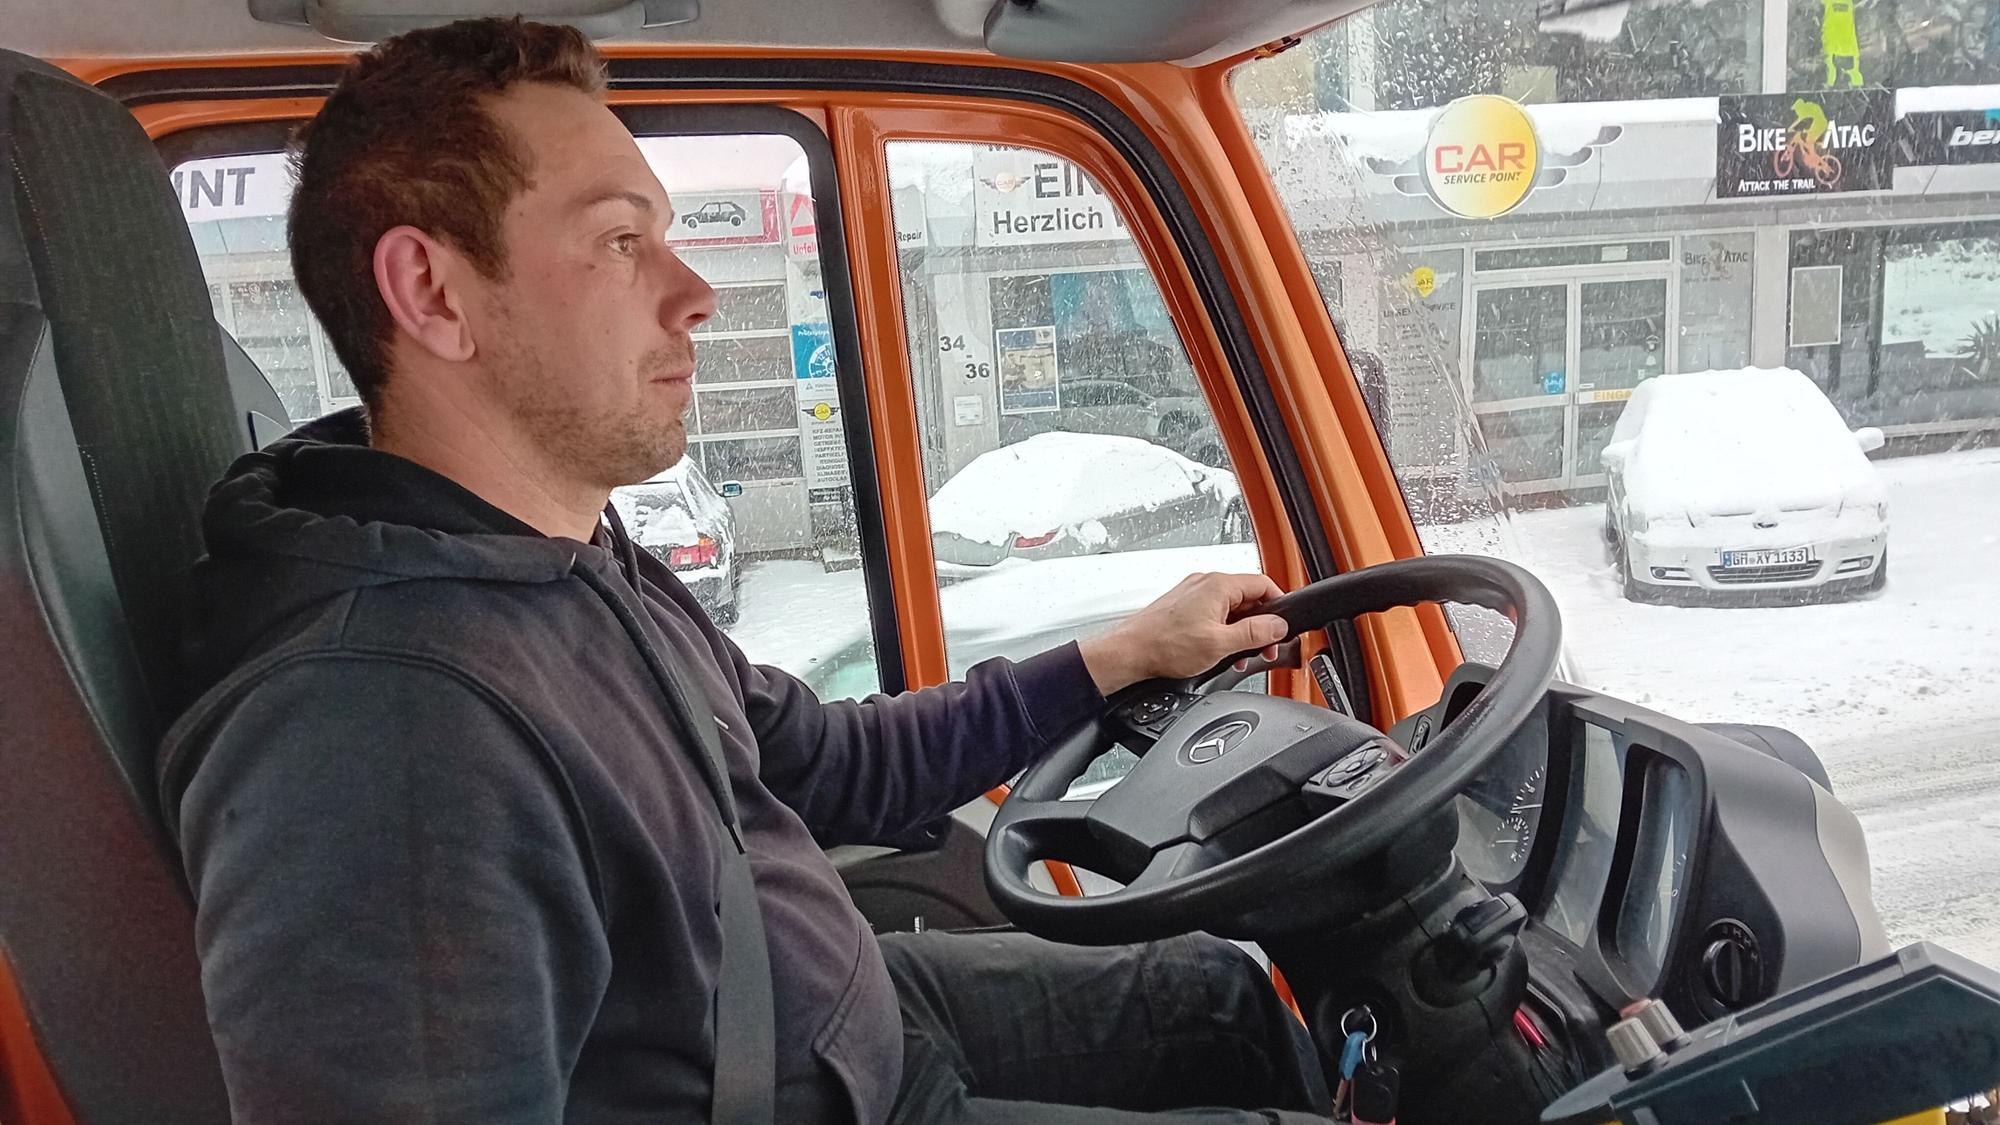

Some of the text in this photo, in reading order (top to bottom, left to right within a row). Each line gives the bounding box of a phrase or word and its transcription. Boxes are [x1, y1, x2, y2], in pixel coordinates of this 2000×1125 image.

[1738, 119, 1876, 153] BIKE ATAC
[1435, 142, 1527, 173] CAR
[1444, 171, 1522, 184] SERVICE POINT
[1738, 178, 1816, 192] ATTACK THE TRAIL
[993, 206, 1104, 235] Herzlich
[939, 334, 966, 352] 34
[965, 362, 990, 379] 36
[1774, 550, 1805, 563] 1133
